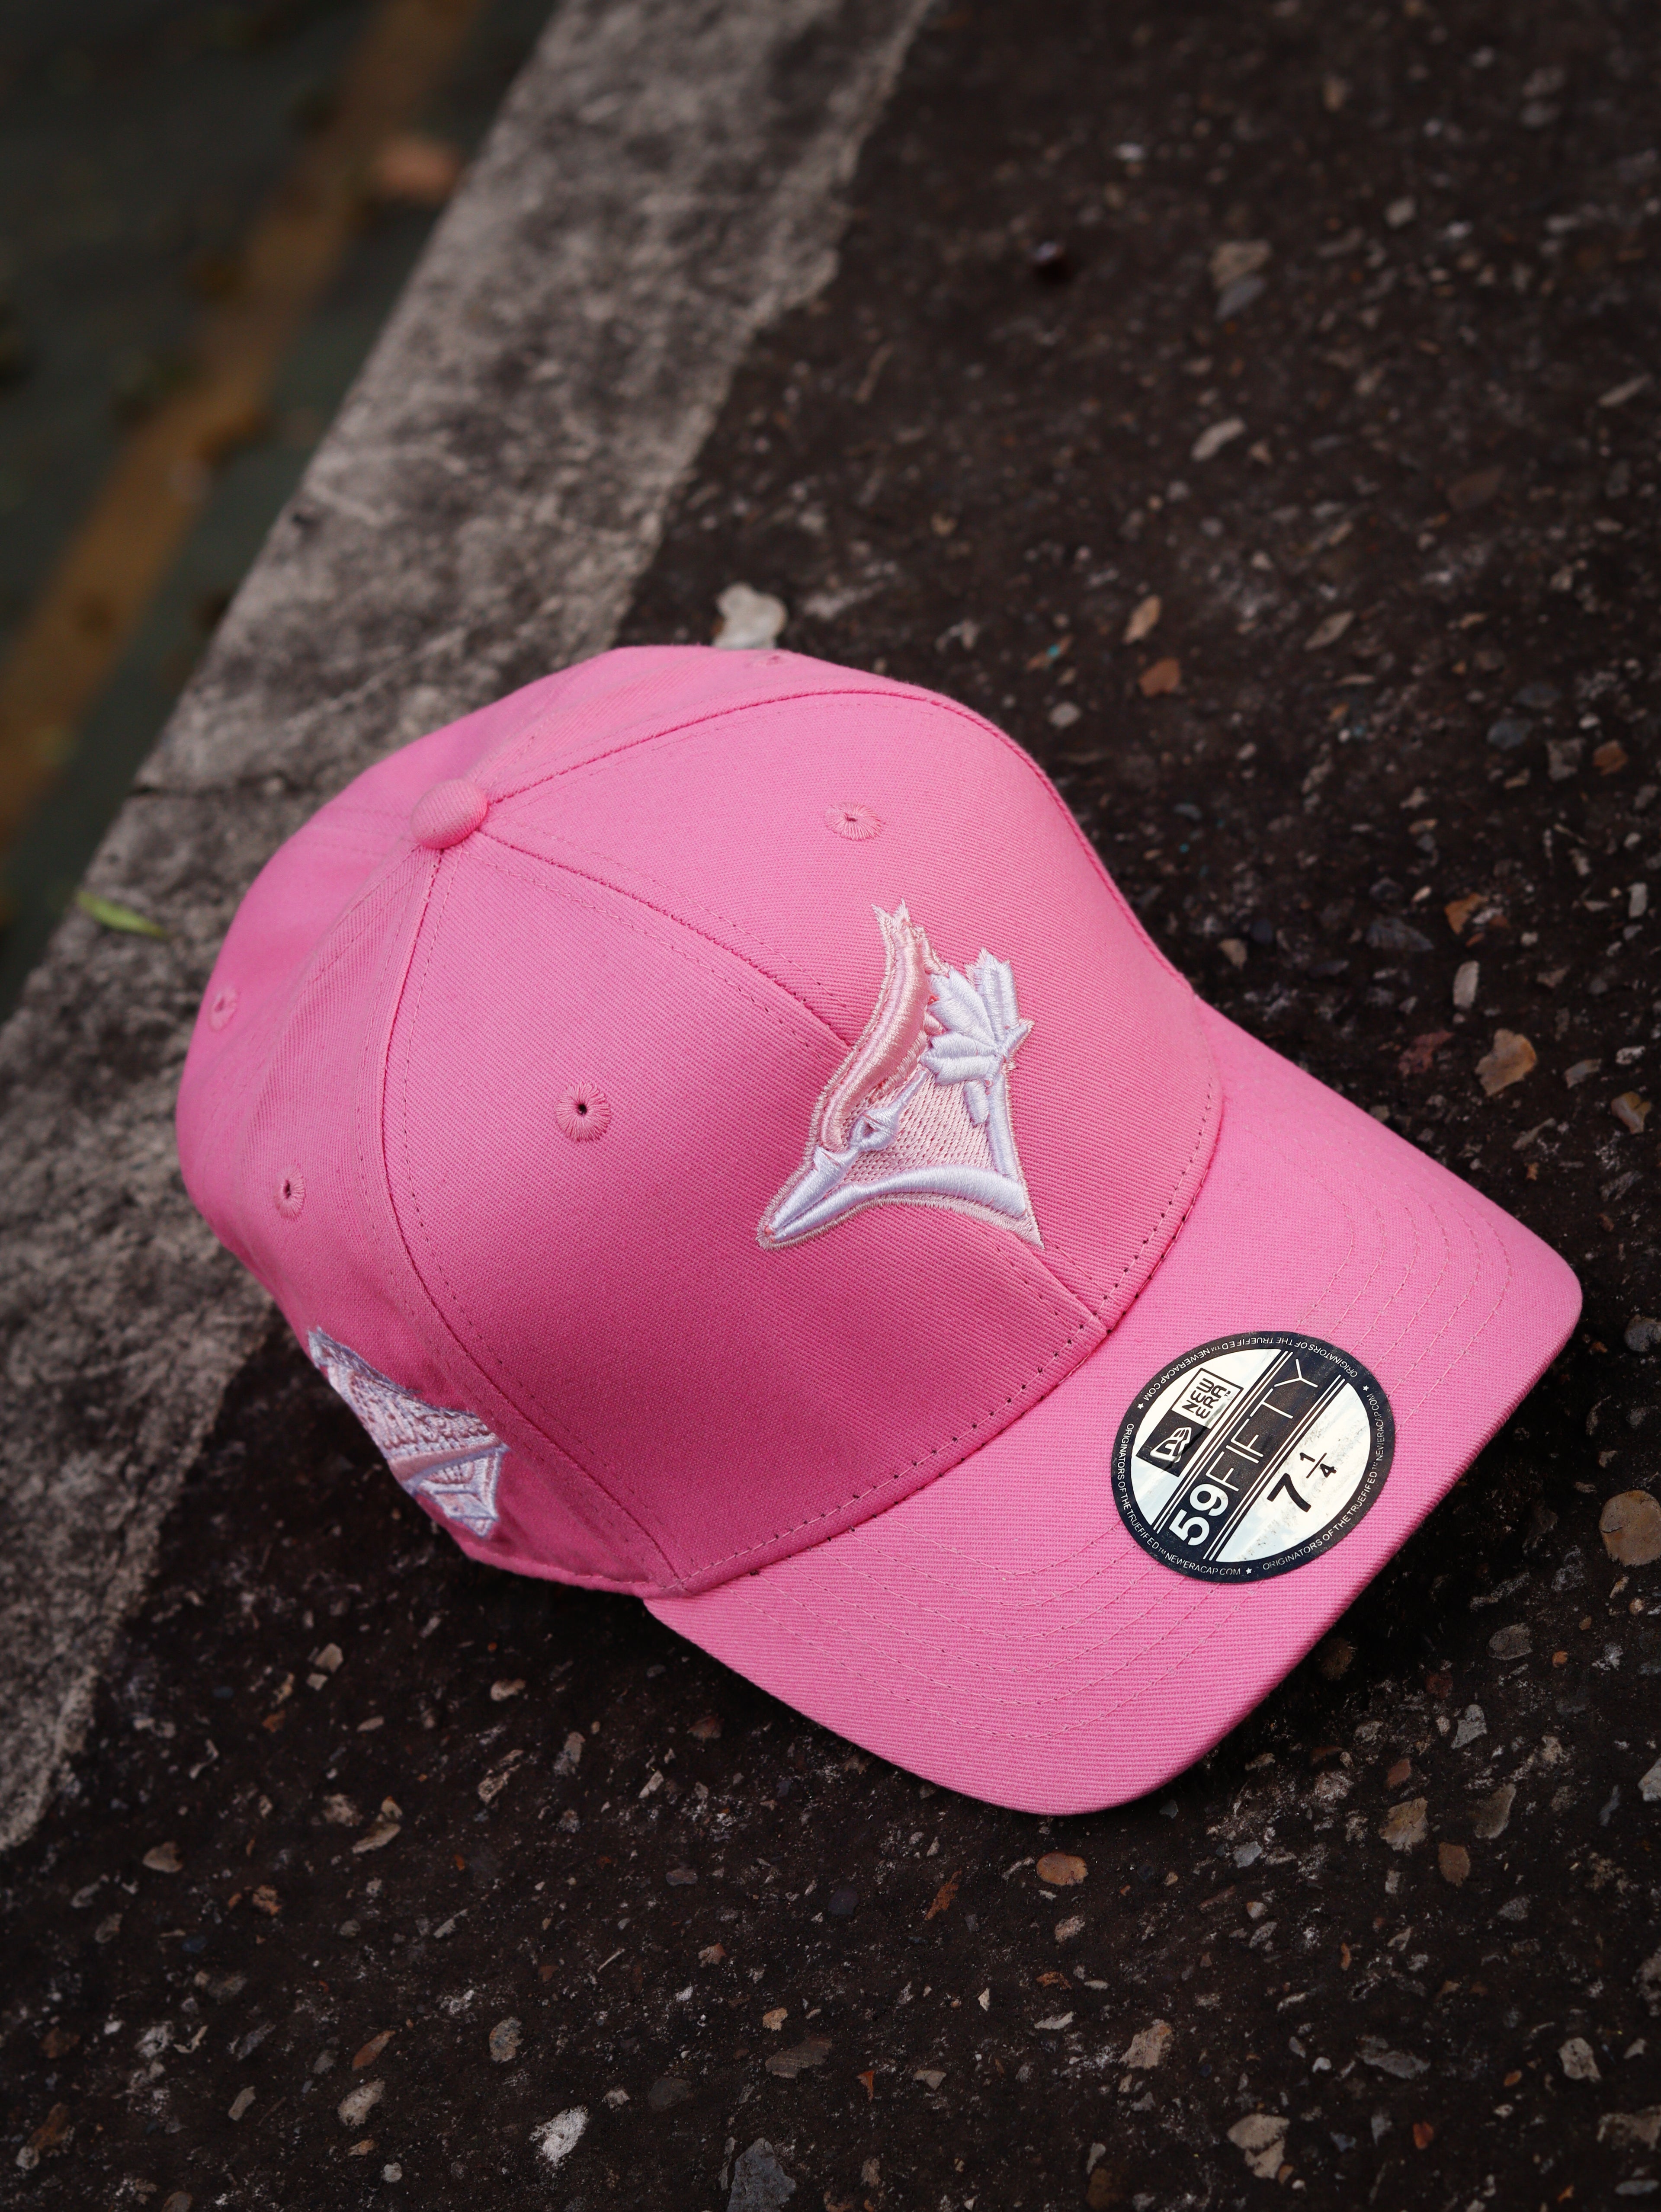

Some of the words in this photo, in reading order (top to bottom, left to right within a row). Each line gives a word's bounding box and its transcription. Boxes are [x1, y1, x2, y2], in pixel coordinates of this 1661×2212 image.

[1276, 1337, 1293, 1346] THE
[1308, 1344, 1358, 1377] ORIGINATORS
[1182, 1378, 1215, 1413] NEW
[1117, 1423, 1134, 1480] ORIGINATORS
[1169, 1358, 1318, 1546] 59FIFTY
[1118, 1481, 1127, 1494] OF
[1121, 1493, 1131, 1511] THE
[1267, 1473, 1311, 1513] 7
[1263, 1539, 1323, 1570] ORIGINATORS
[1322, 1529, 1334, 1541] OF
[1333, 1514, 1351, 1531] THE
